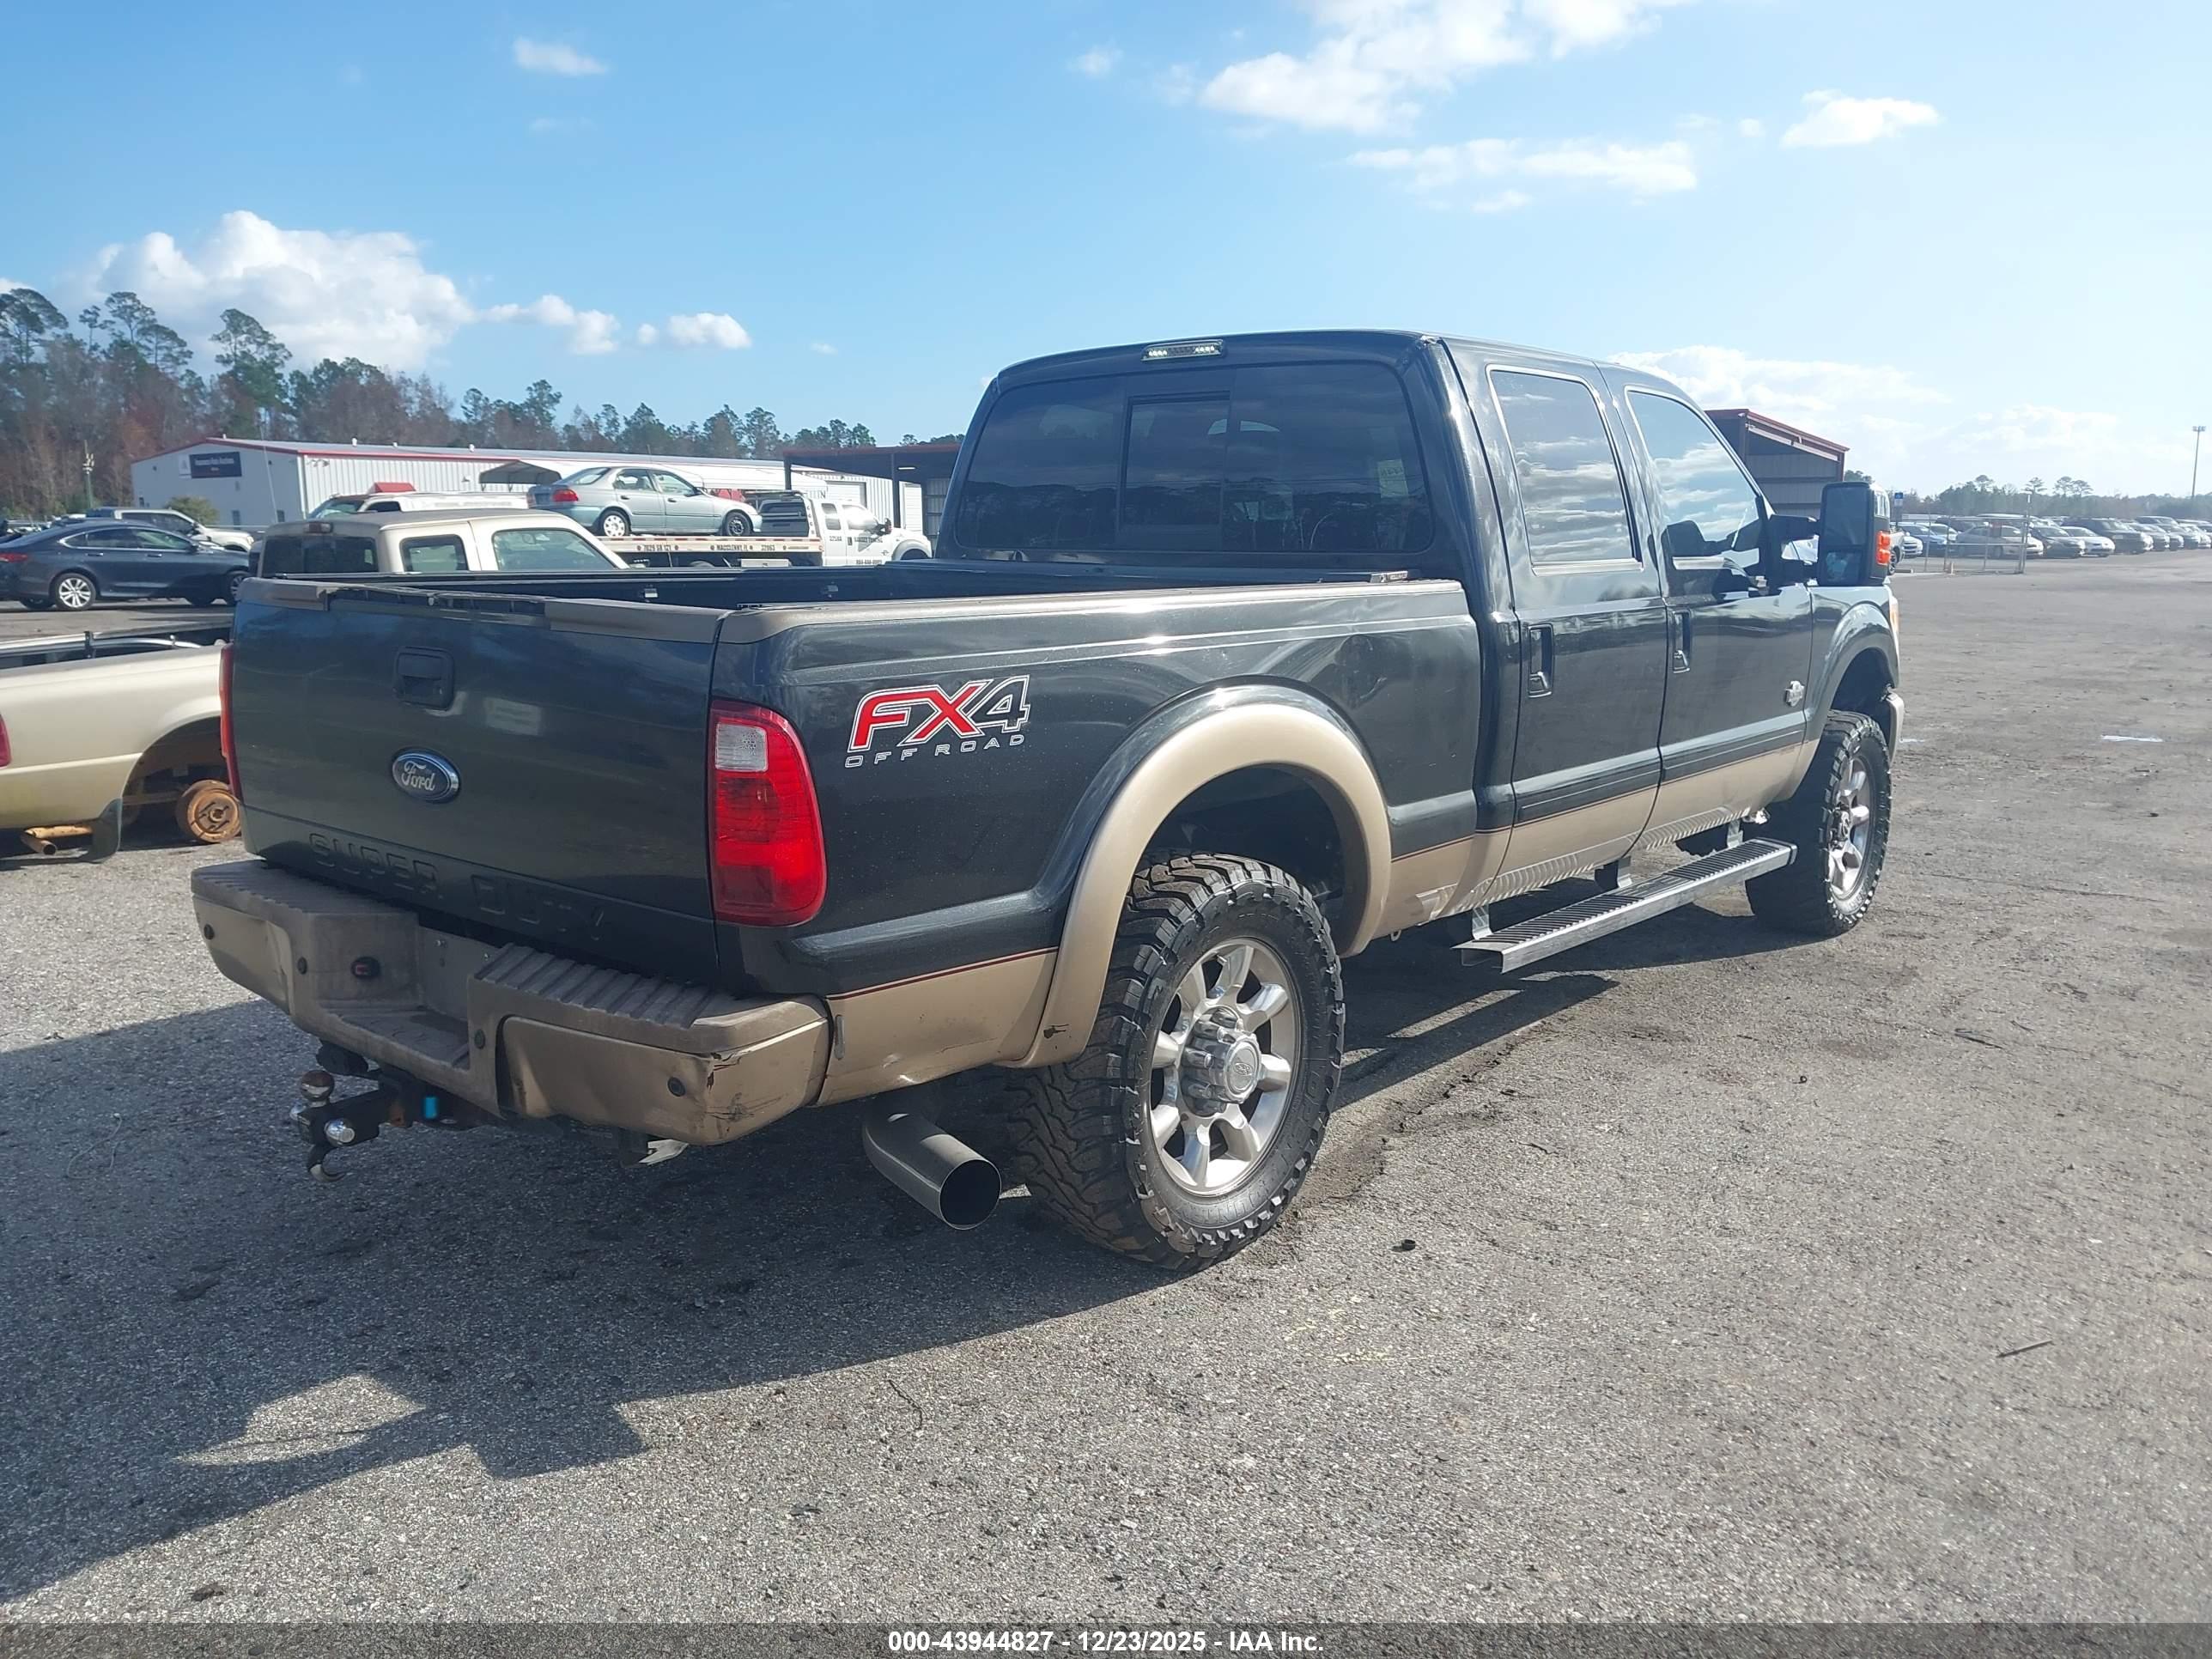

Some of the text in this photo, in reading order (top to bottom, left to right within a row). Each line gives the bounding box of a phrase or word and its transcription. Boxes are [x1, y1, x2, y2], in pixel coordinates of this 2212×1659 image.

[847, 674, 1031, 754] FX4
[401, 760, 436, 791] Ford
[845, 734, 1025, 769] OFF ROAD
[308, 832, 444, 900] SUPER
